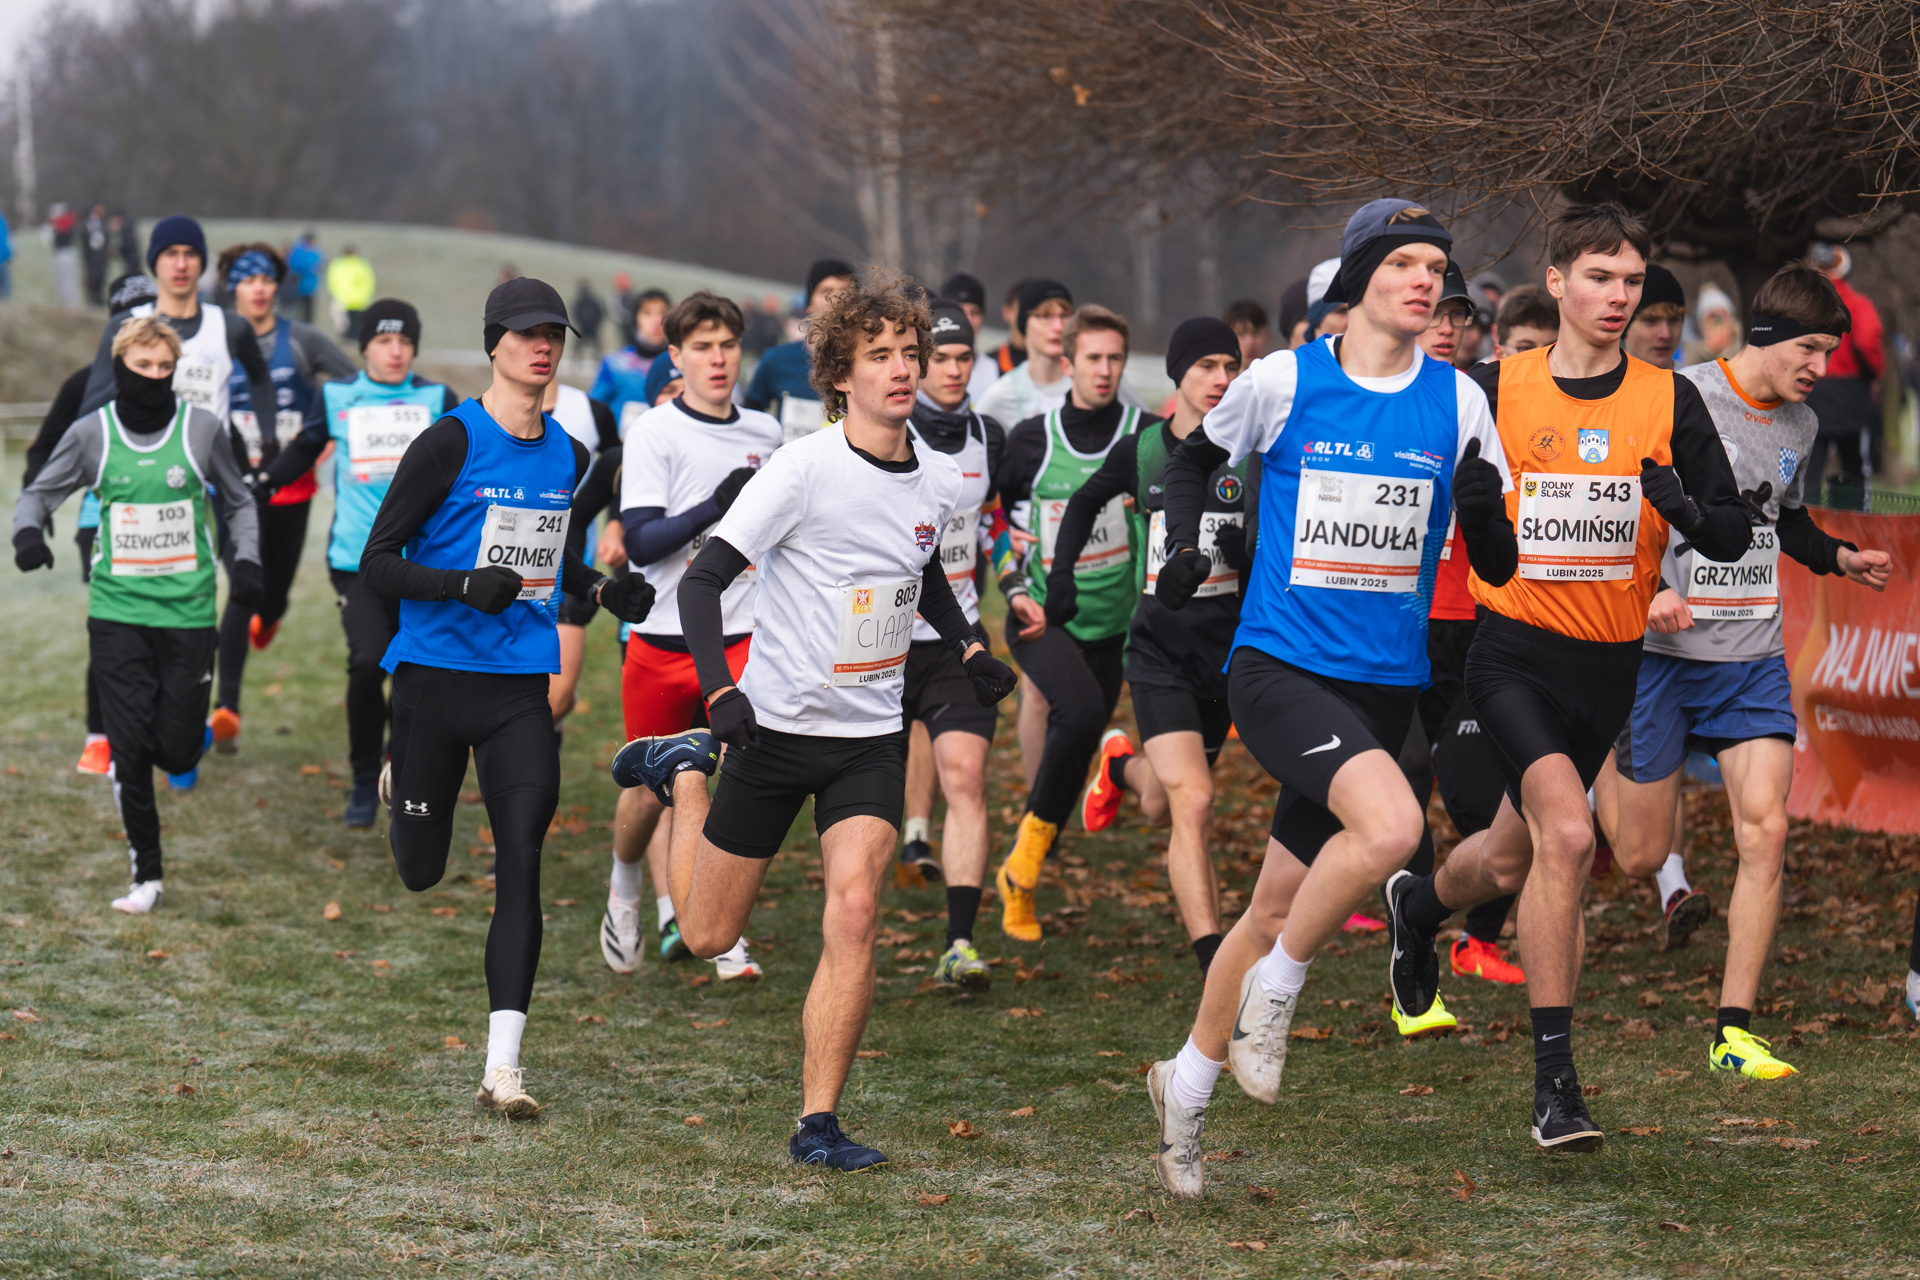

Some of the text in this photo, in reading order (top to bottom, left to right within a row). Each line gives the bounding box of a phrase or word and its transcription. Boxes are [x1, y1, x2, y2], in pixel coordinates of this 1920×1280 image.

[1314, 441, 1353, 456] RLTL
[483, 487, 511, 499] RLTL
[1541, 481, 1574, 490] DOLNY
[1587, 482, 1631, 502] 543
[1375, 484, 1420, 507] 231
[1541, 489, 1572, 499] ŚLĄSK
[158, 507, 186, 522] 103
[536, 516, 563, 533] 241
[1522, 515, 1635, 542] SŁOMIŃSKI
[115, 531, 191, 550] SZEWCZUK
[1300, 519, 1417, 551] JANDUŁA
[487, 544, 556, 567] OZIMEK
[1546, 568, 1604, 577] LUBIN 2025
[1694, 565, 1772, 586] GRZYMSKI
[1326, 576, 1388, 588] LUBIN 2025
[895, 584, 917, 607] 803
[854, 605, 872, 613] PZLA
[1712, 609, 1735, 617] LUBIN
[859, 669, 897, 683] LUBIN 2025
